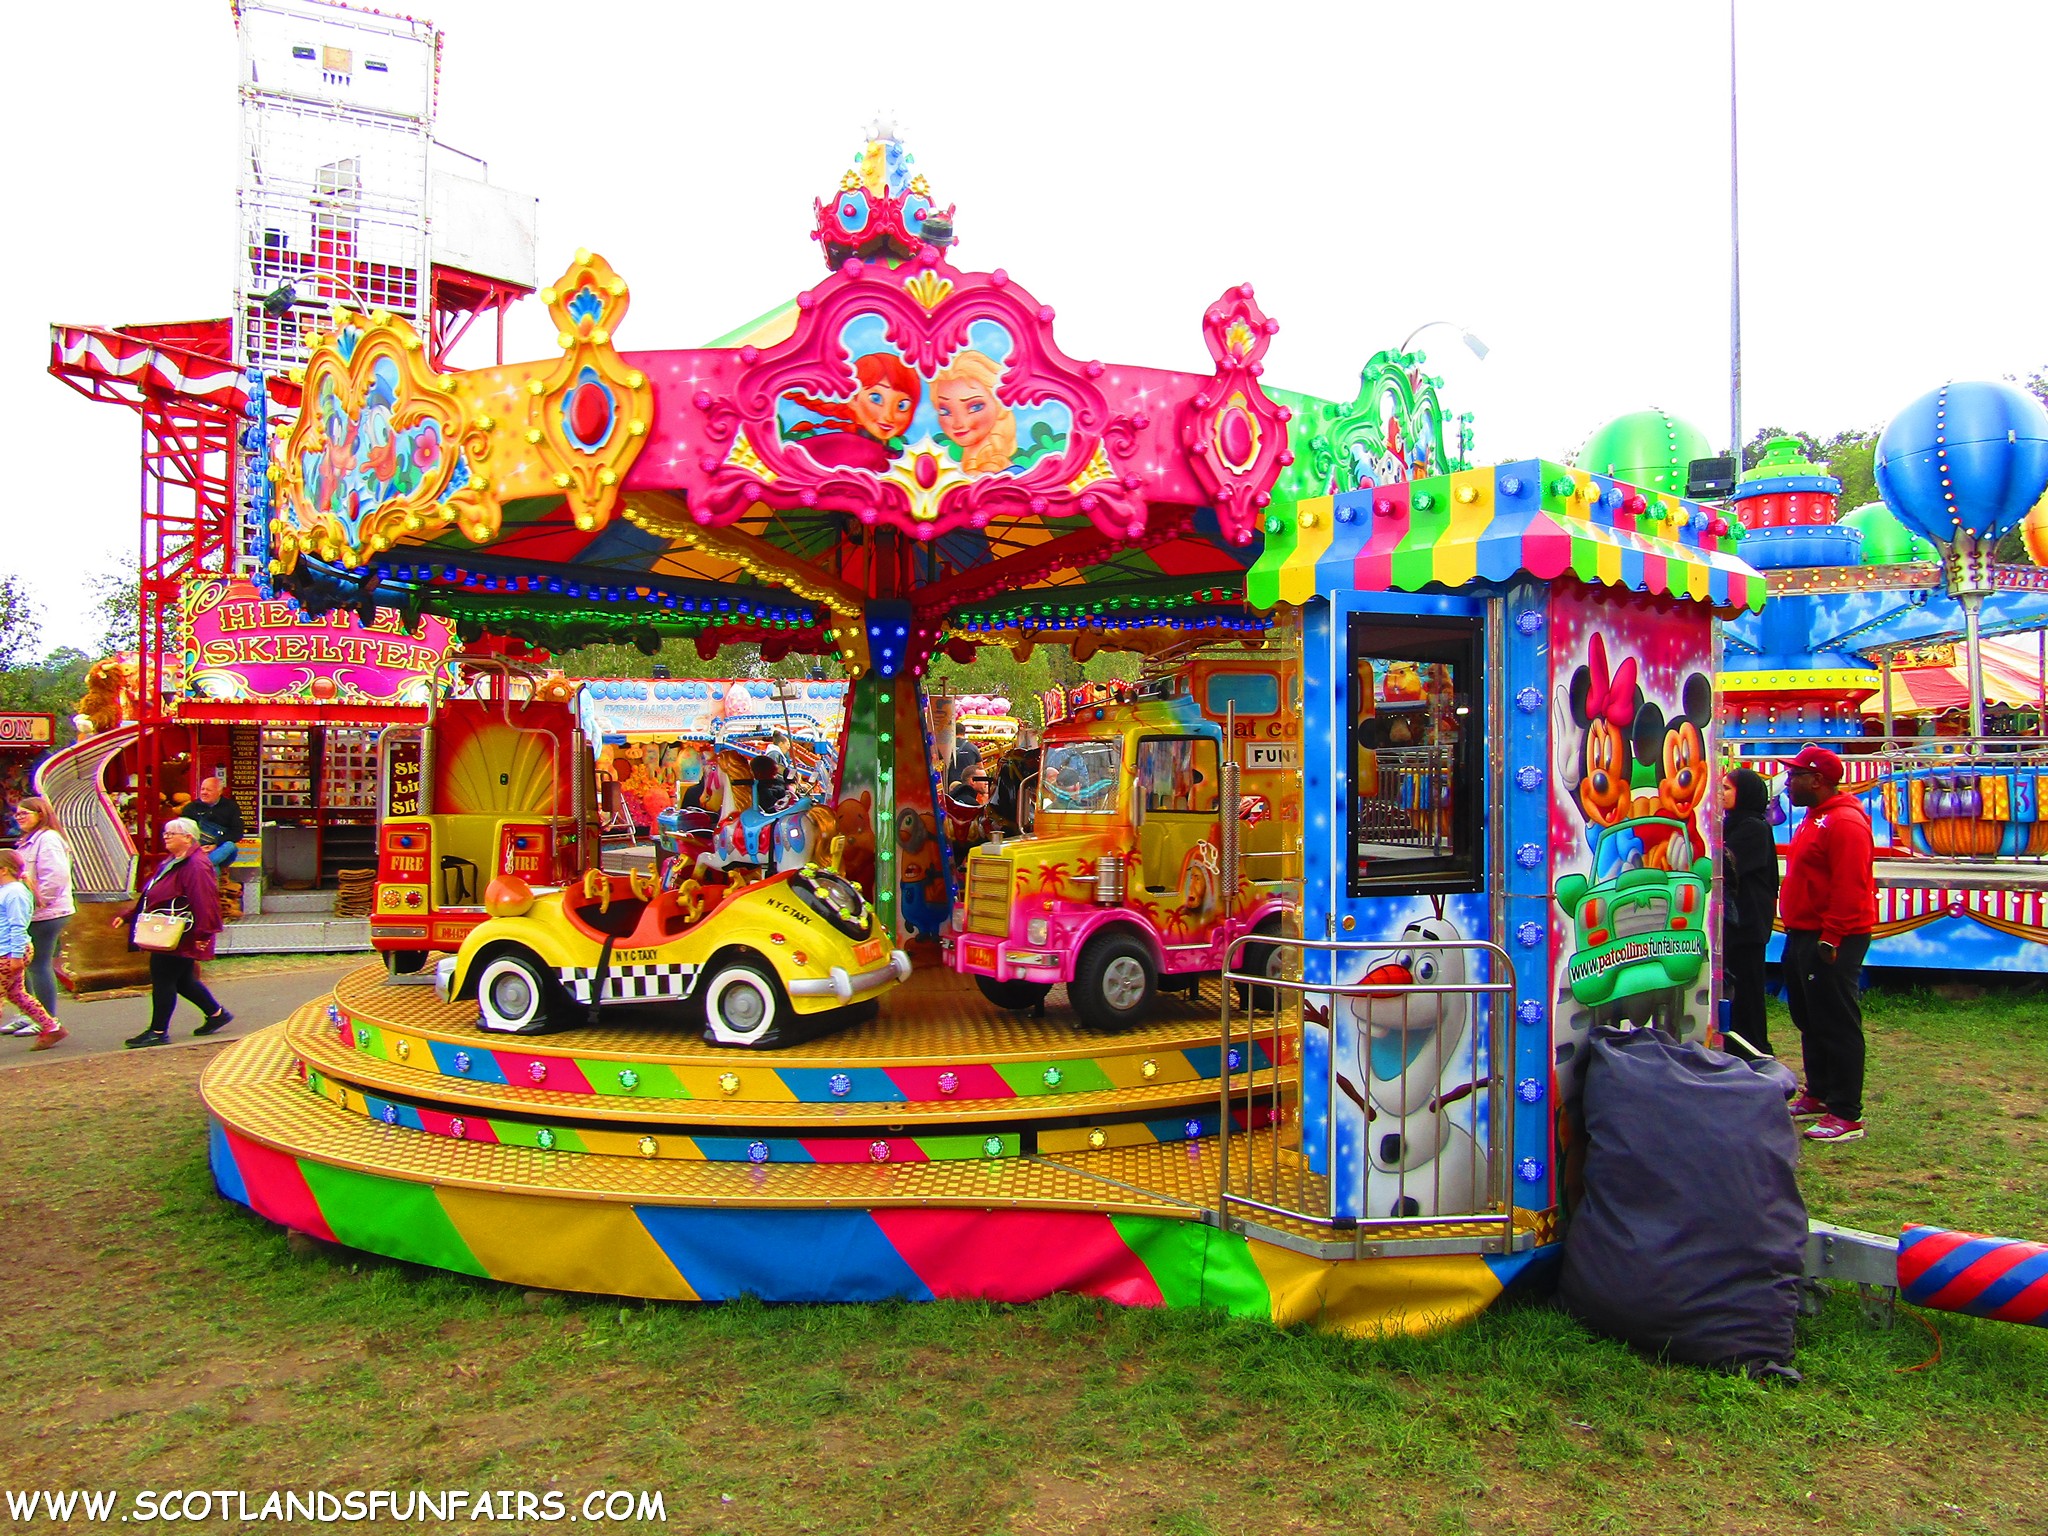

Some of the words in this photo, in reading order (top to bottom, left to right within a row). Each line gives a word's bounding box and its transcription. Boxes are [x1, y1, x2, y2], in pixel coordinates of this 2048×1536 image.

[203, 634, 441, 673] SKELTER
[585, 681, 649, 701] CORE
[653, 681, 709, 701] OVER
[711, 682, 724, 701] 3
[604, 704, 636, 714] EVERY
[638, 704, 674, 714] PLAYER
[676, 704, 700, 714] GETS
[0, 718, 33, 740] ON
[392, 798, 419, 814] Sli
[2015, 781, 2030, 813] 3
[390, 856, 425, 871] FIRE
[513, 856, 539, 871] IRE
[1570, 936, 1702, 983] www.patcollinsfunfairs.co.uk
